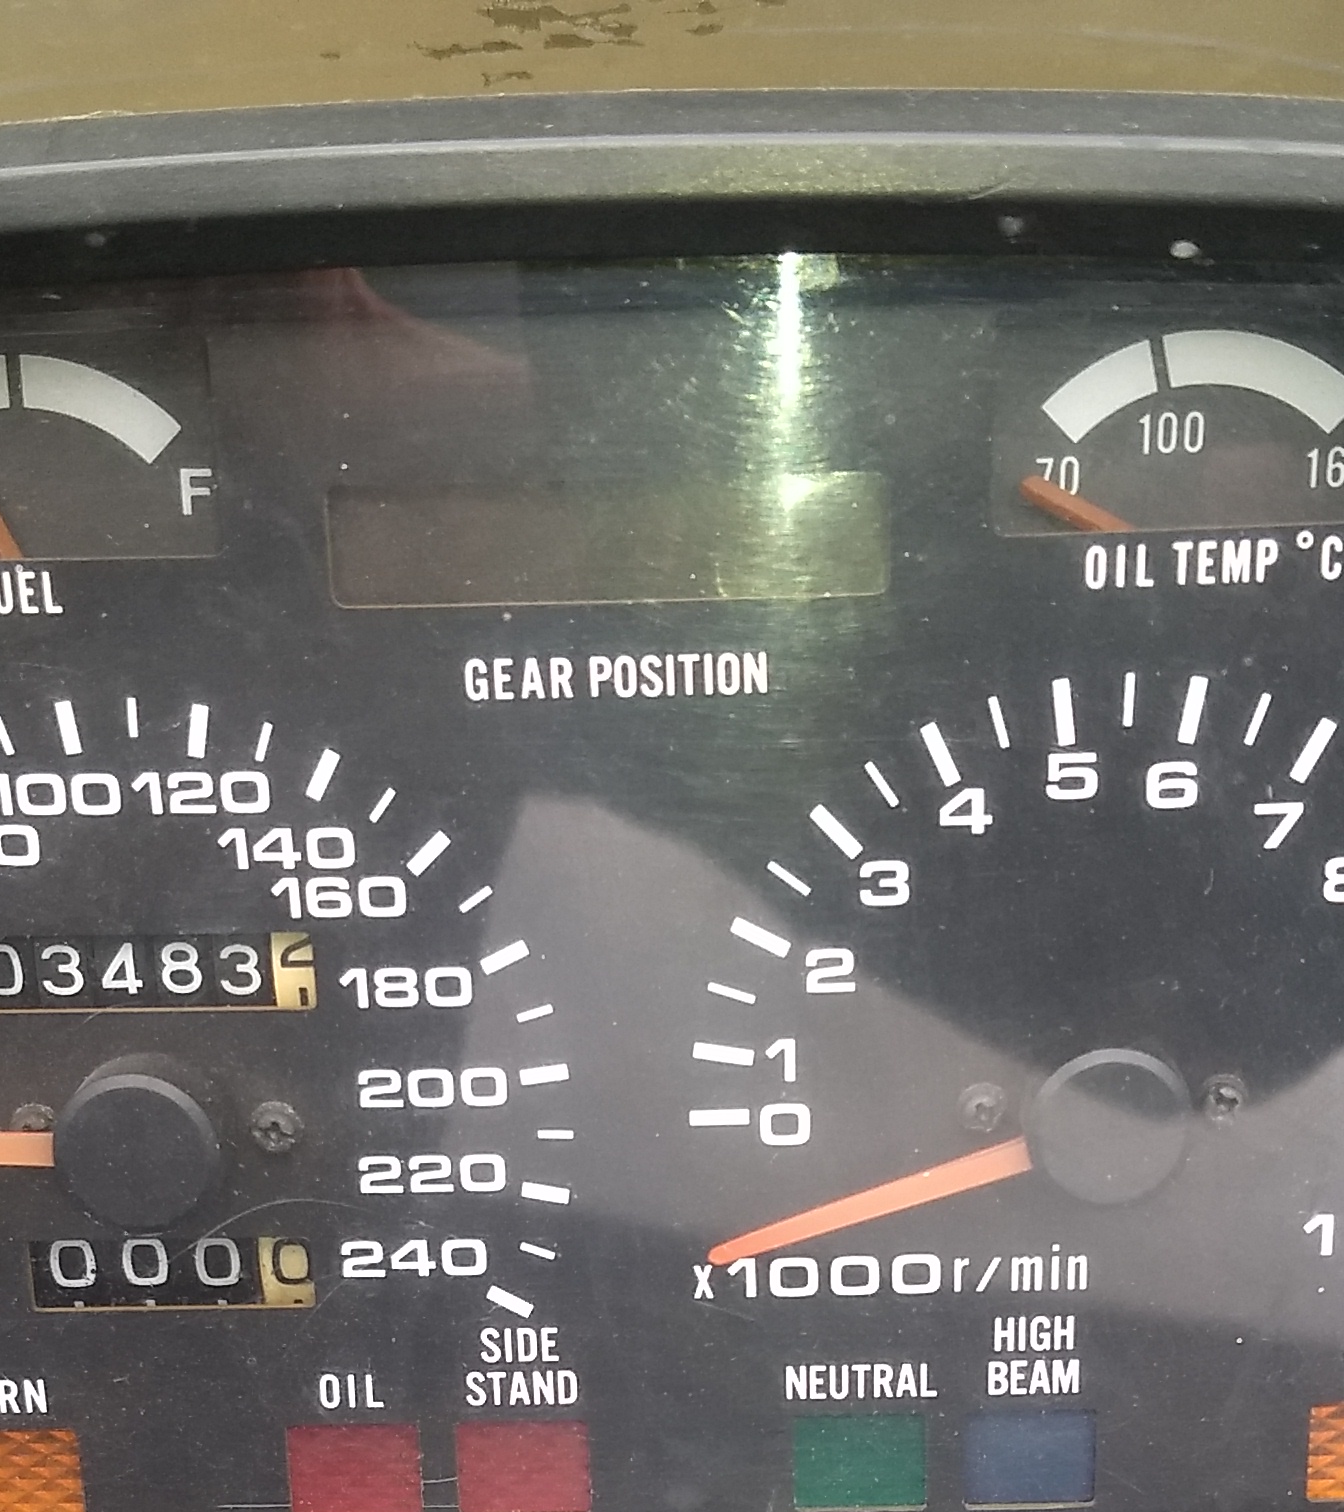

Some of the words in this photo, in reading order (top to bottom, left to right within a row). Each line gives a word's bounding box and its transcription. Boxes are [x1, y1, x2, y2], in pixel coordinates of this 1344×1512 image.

[1139, 411, 1205, 455] 100
[179, 468, 212, 516] F
[1035, 455, 1080, 496] 70
[1084, 543, 1155, 590] OIL
[1172, 538, 1279, 586] TEMP
[464, 656, 574, 701] GEAR
[588, 651, 768, 698] POSITION
[131, 770, 271, 815] 120
[1045, 751, 1099, 800] 5
[1145, 760, 1199, 809] 6
[939, 787, 993, 835] 4
[1253, 801, 1305, 850] 7
[217, 826, 356, 870] 140
[270, 875, 407, 919] 160
[859, 859, 910, 907] 3
[339, 966, 473, 1009] 180
[805, 947, 856, 994] 2
[765, 1038, 796, 1083] 1
[357, 1066, 508, 1108] 200
[759, 1102, 811, 1146] 0
[358, 1153, 507, 1194] 220
[340, 1238, 488, 1278] 240
[480, 1326, 560, 1364] SIDE
[993, 1315, 1075, 1352] HIGH
[319, 1373, 385, 1409] OIL
[465, 1369, 578, 1407] STAND
[785, 1362, 938, 1400] NEUTRAL
[987, 1358, 1080, 1396] BEAM
